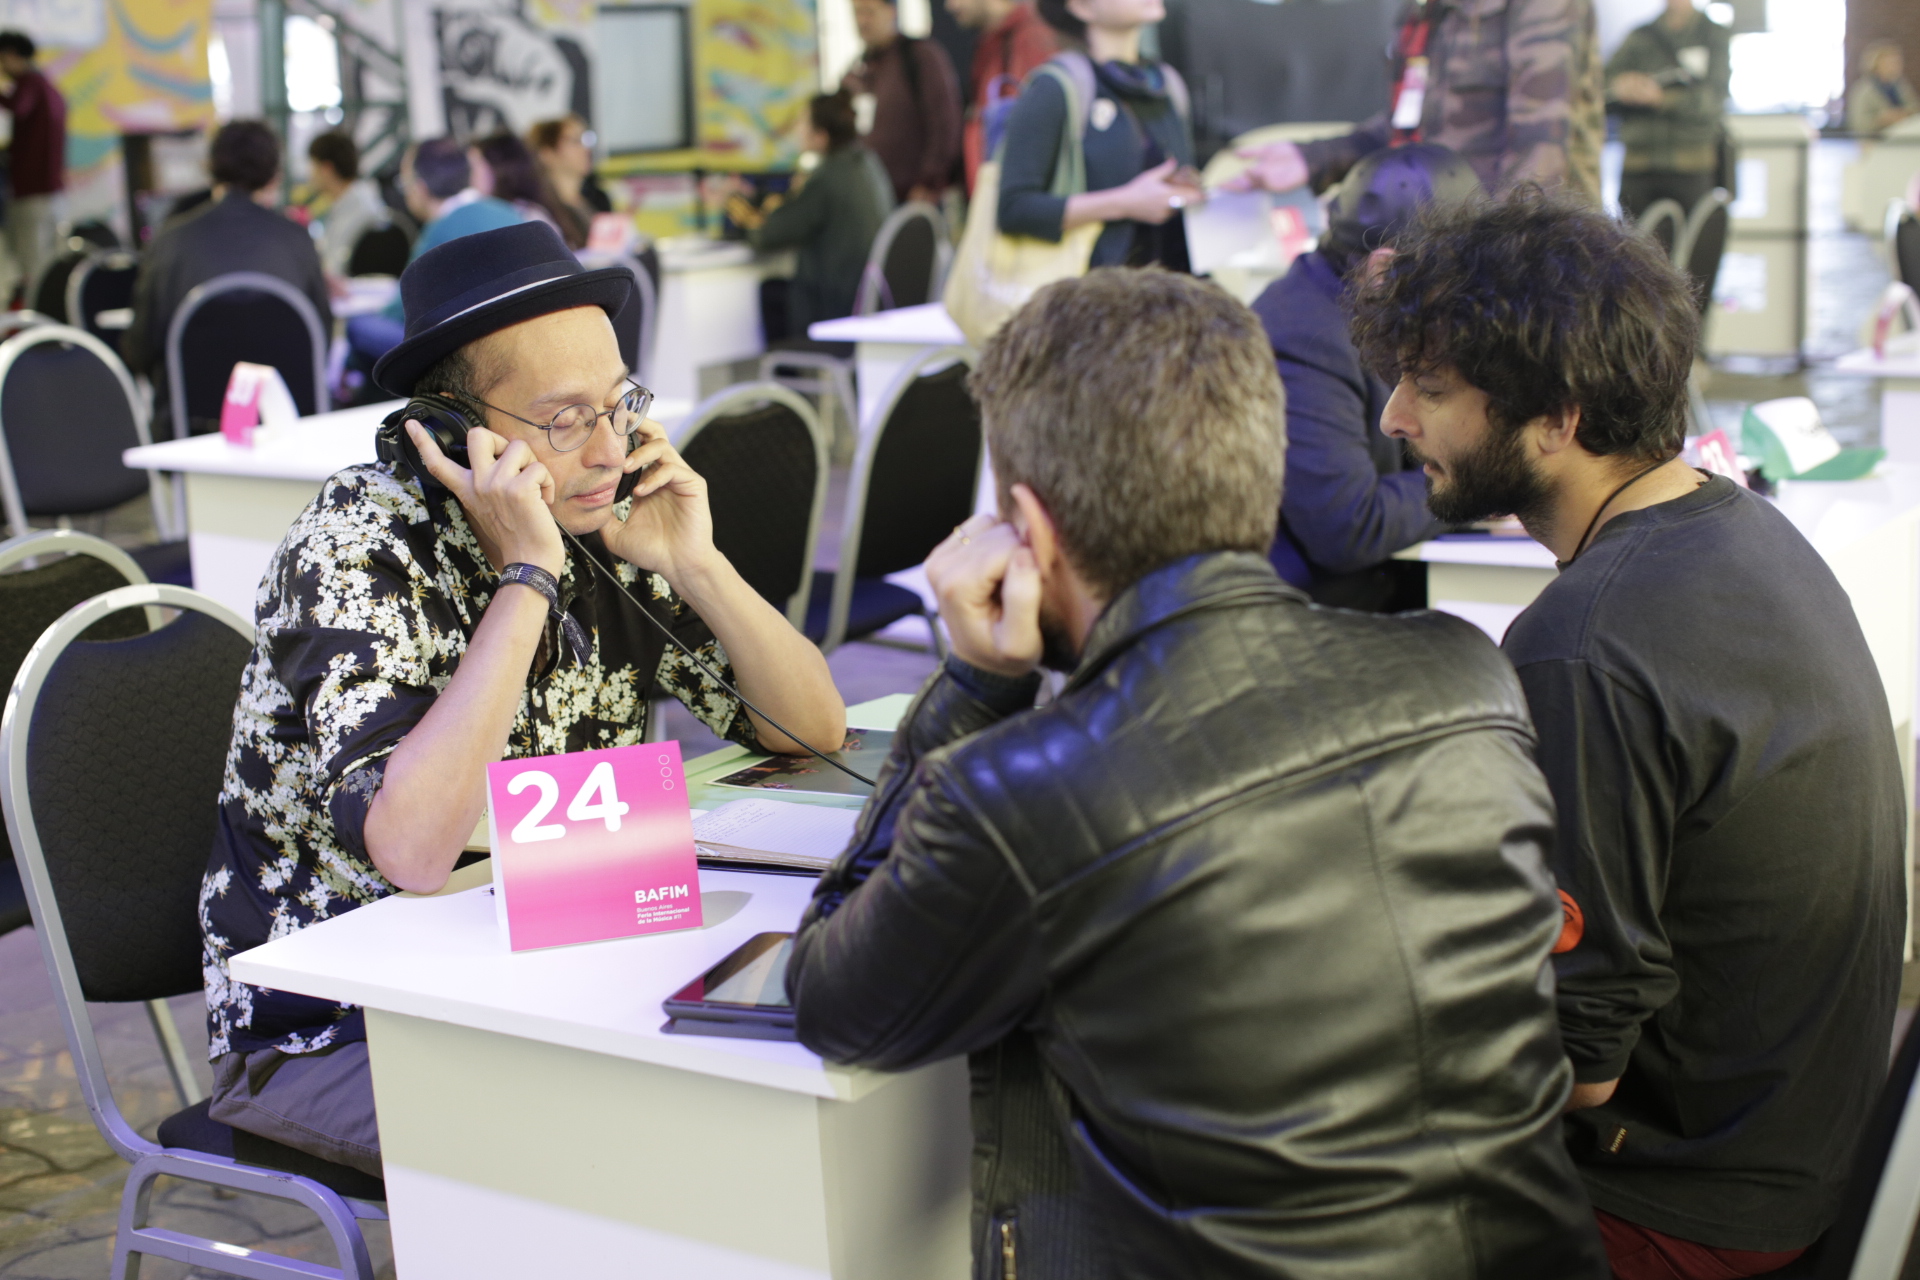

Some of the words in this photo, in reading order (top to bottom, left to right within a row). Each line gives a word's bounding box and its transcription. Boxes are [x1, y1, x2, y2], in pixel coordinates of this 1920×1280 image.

[507, 761, 630, 844] 24
[634, 884, 689, 904] BAFIM
[652, 906, 690, 917] Internacional
